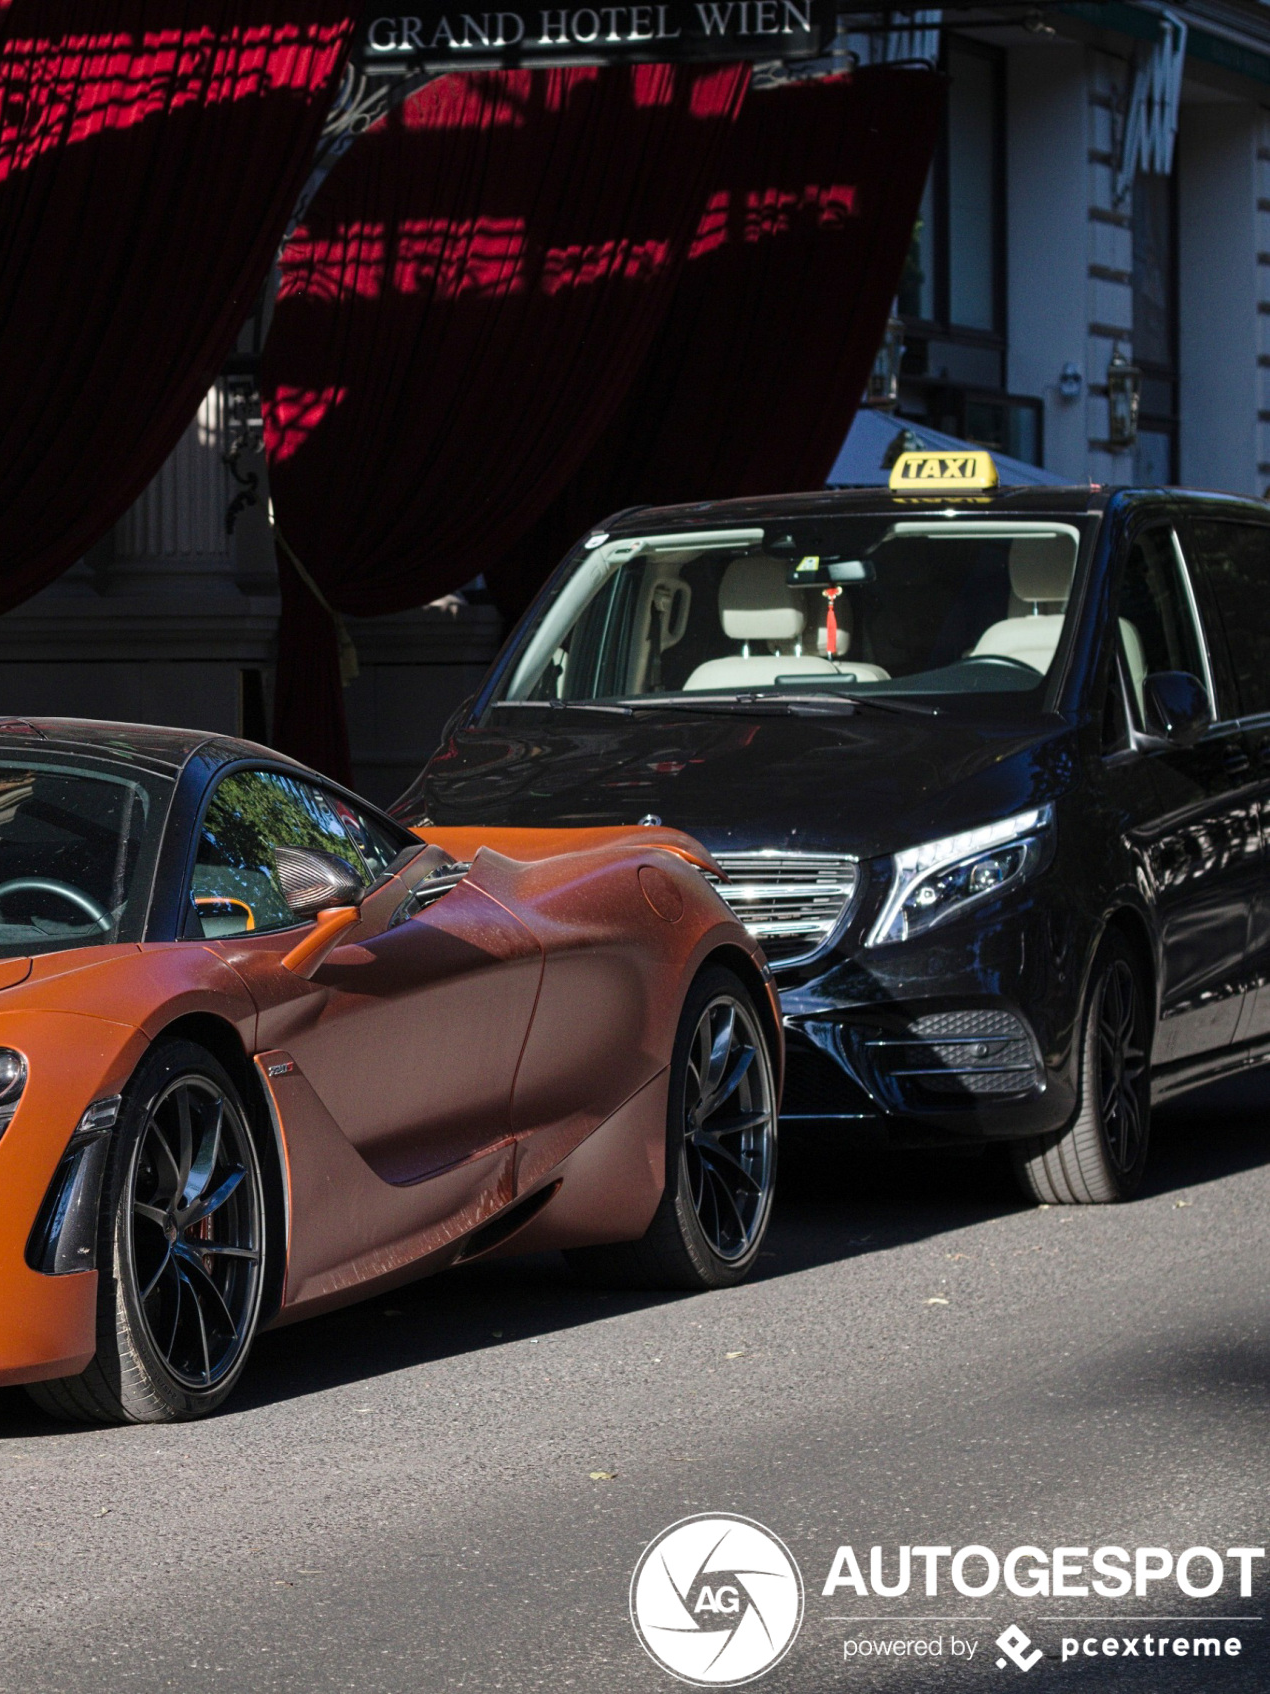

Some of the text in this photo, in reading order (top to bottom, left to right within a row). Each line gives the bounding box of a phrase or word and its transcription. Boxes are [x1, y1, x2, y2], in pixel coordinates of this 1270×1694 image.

[367, 0, 812, 51] GRAND HOTEL WIEN
[905, 459, 975, 478] TAXI
